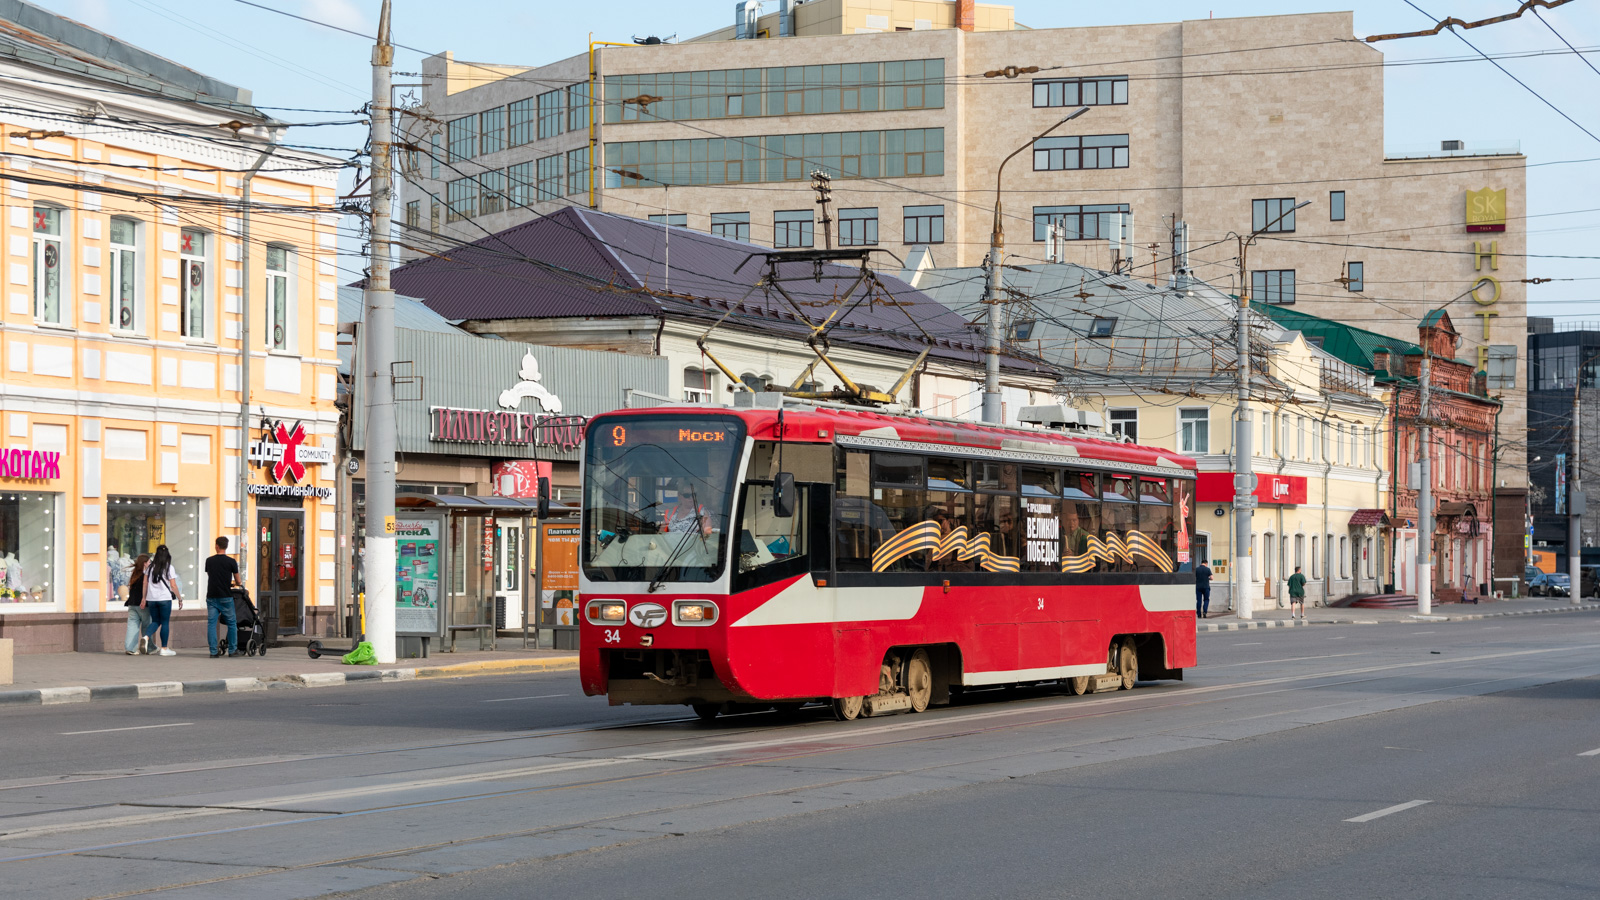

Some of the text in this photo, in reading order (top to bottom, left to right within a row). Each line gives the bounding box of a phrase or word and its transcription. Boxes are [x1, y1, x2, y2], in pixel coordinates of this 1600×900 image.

[1472, 195, 1498, 214] SK
[612, 425, 626, 446] 9
[0, 448, 61, 480] КОТАЖ
[1027, 515, 1060, 540] ВЕЛИКОЙ
[1027, 540, 1060, 566] ПОБЕДЫ!
[1037, 597, 1044, 610] 34
[604, 629, 621, 643] 34
